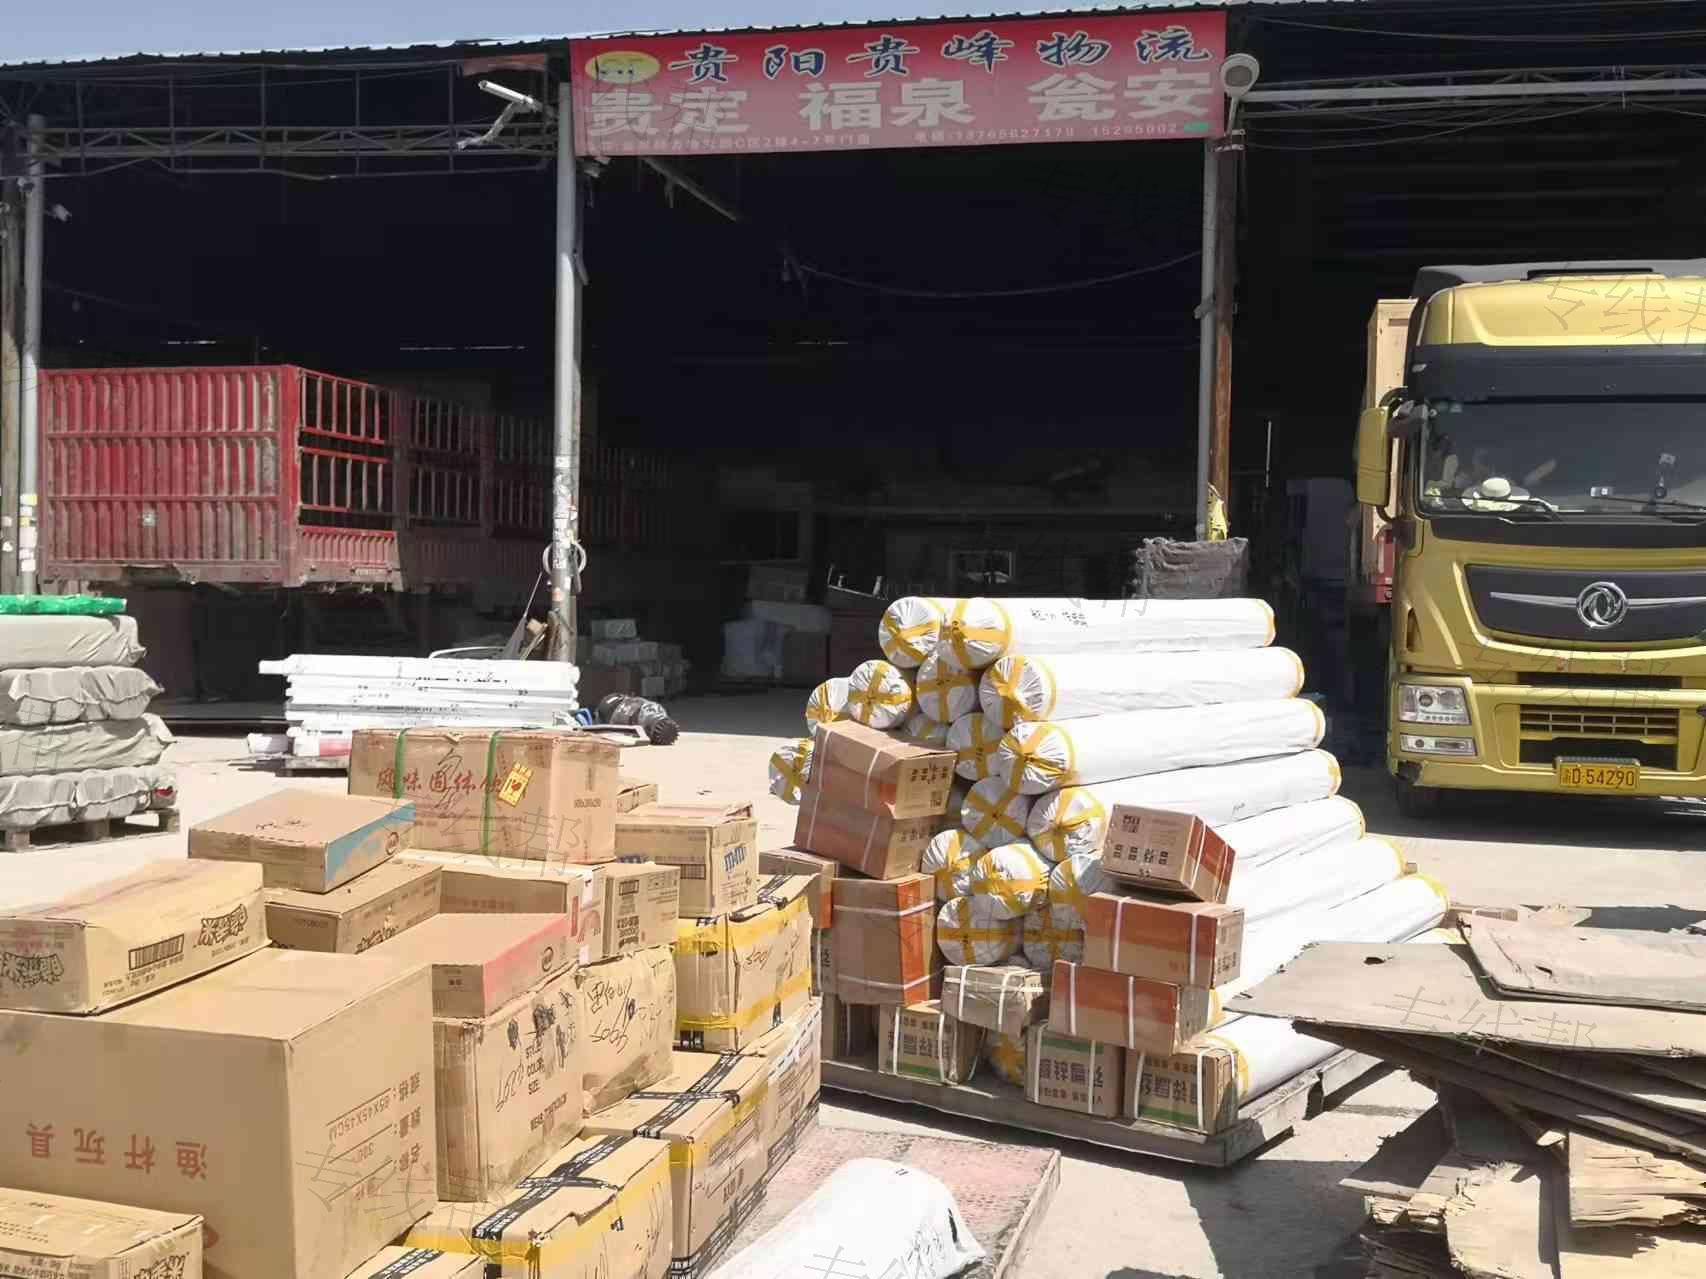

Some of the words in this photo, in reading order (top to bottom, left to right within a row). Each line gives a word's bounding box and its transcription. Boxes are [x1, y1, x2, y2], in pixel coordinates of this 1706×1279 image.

[668, 25, 1213, 84] 贵阳贵峰物流
[799, 77, 977, 131] 福泉
[1027, 67, 1212, 121] 瓮安
